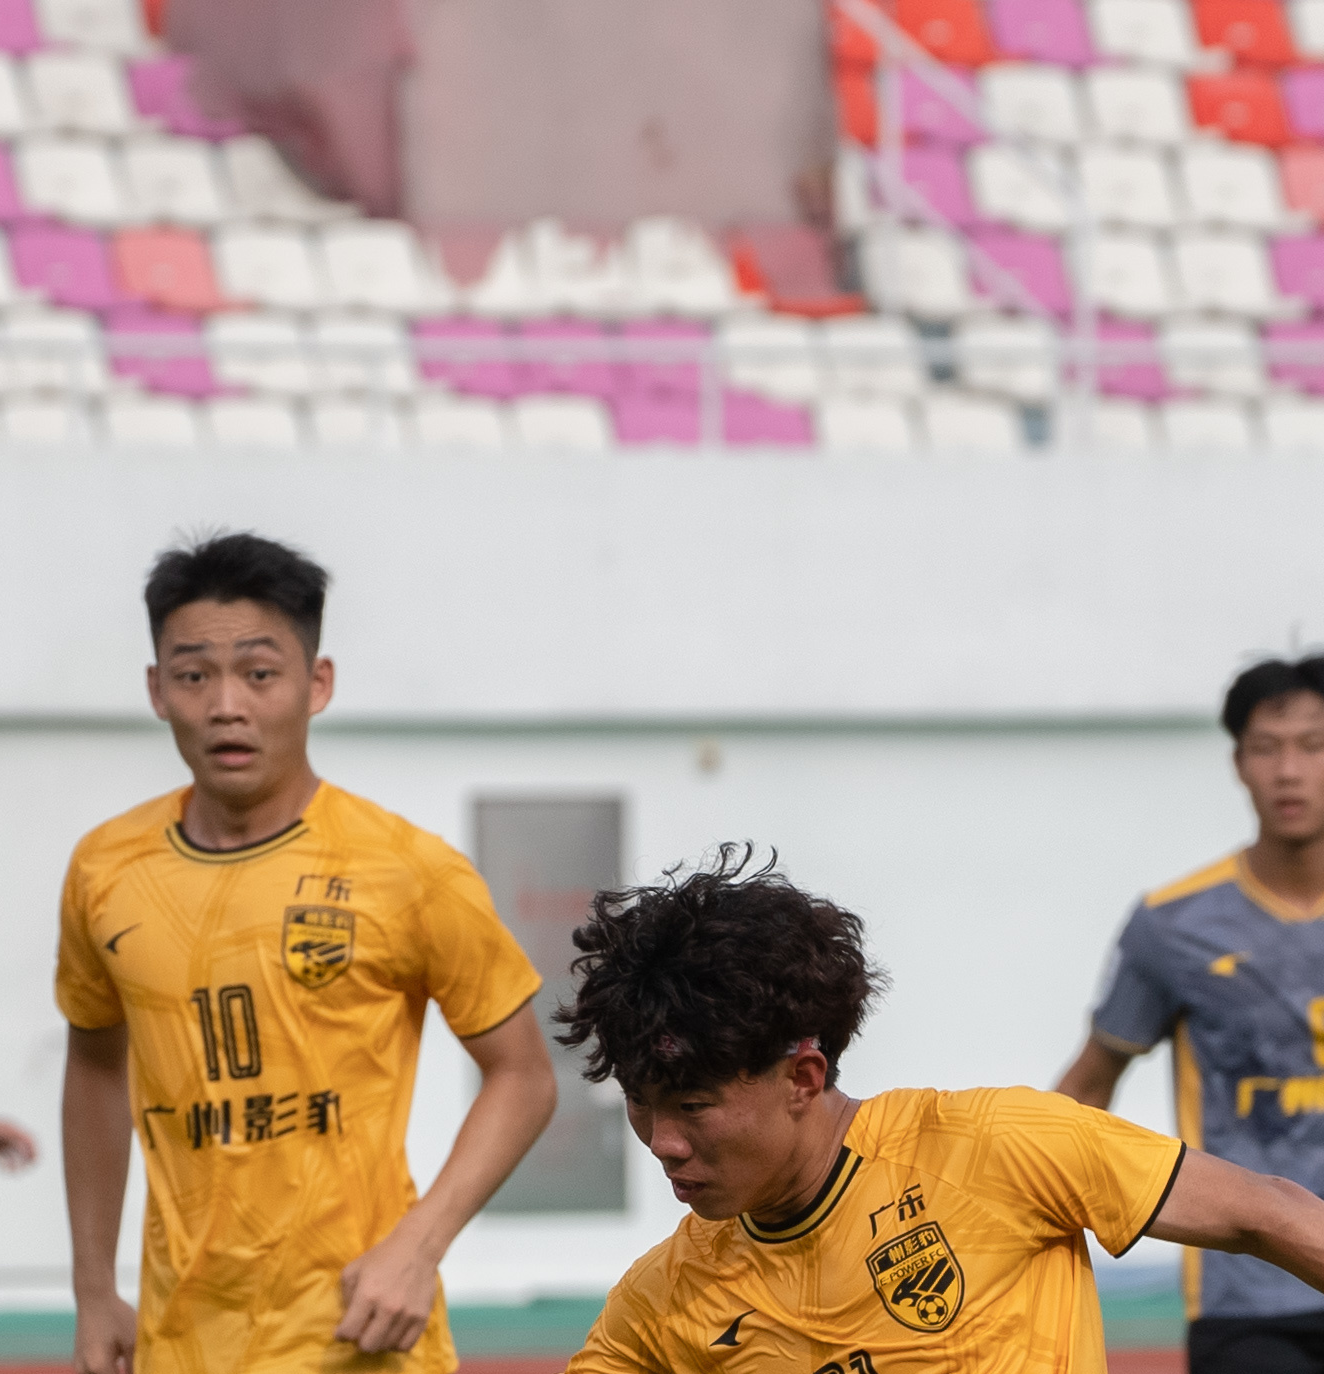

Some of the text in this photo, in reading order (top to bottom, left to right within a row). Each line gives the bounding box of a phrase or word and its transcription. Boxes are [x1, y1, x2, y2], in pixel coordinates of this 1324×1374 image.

[190, 983, 262, 1082] 10
[143, 1089, 345, 1150] 广州影豹
[868, 1183, 926, 1240] 广东
[872, 1229, 937, 1274] 广州影豹
[929, 1247, 945, 1262] FC
